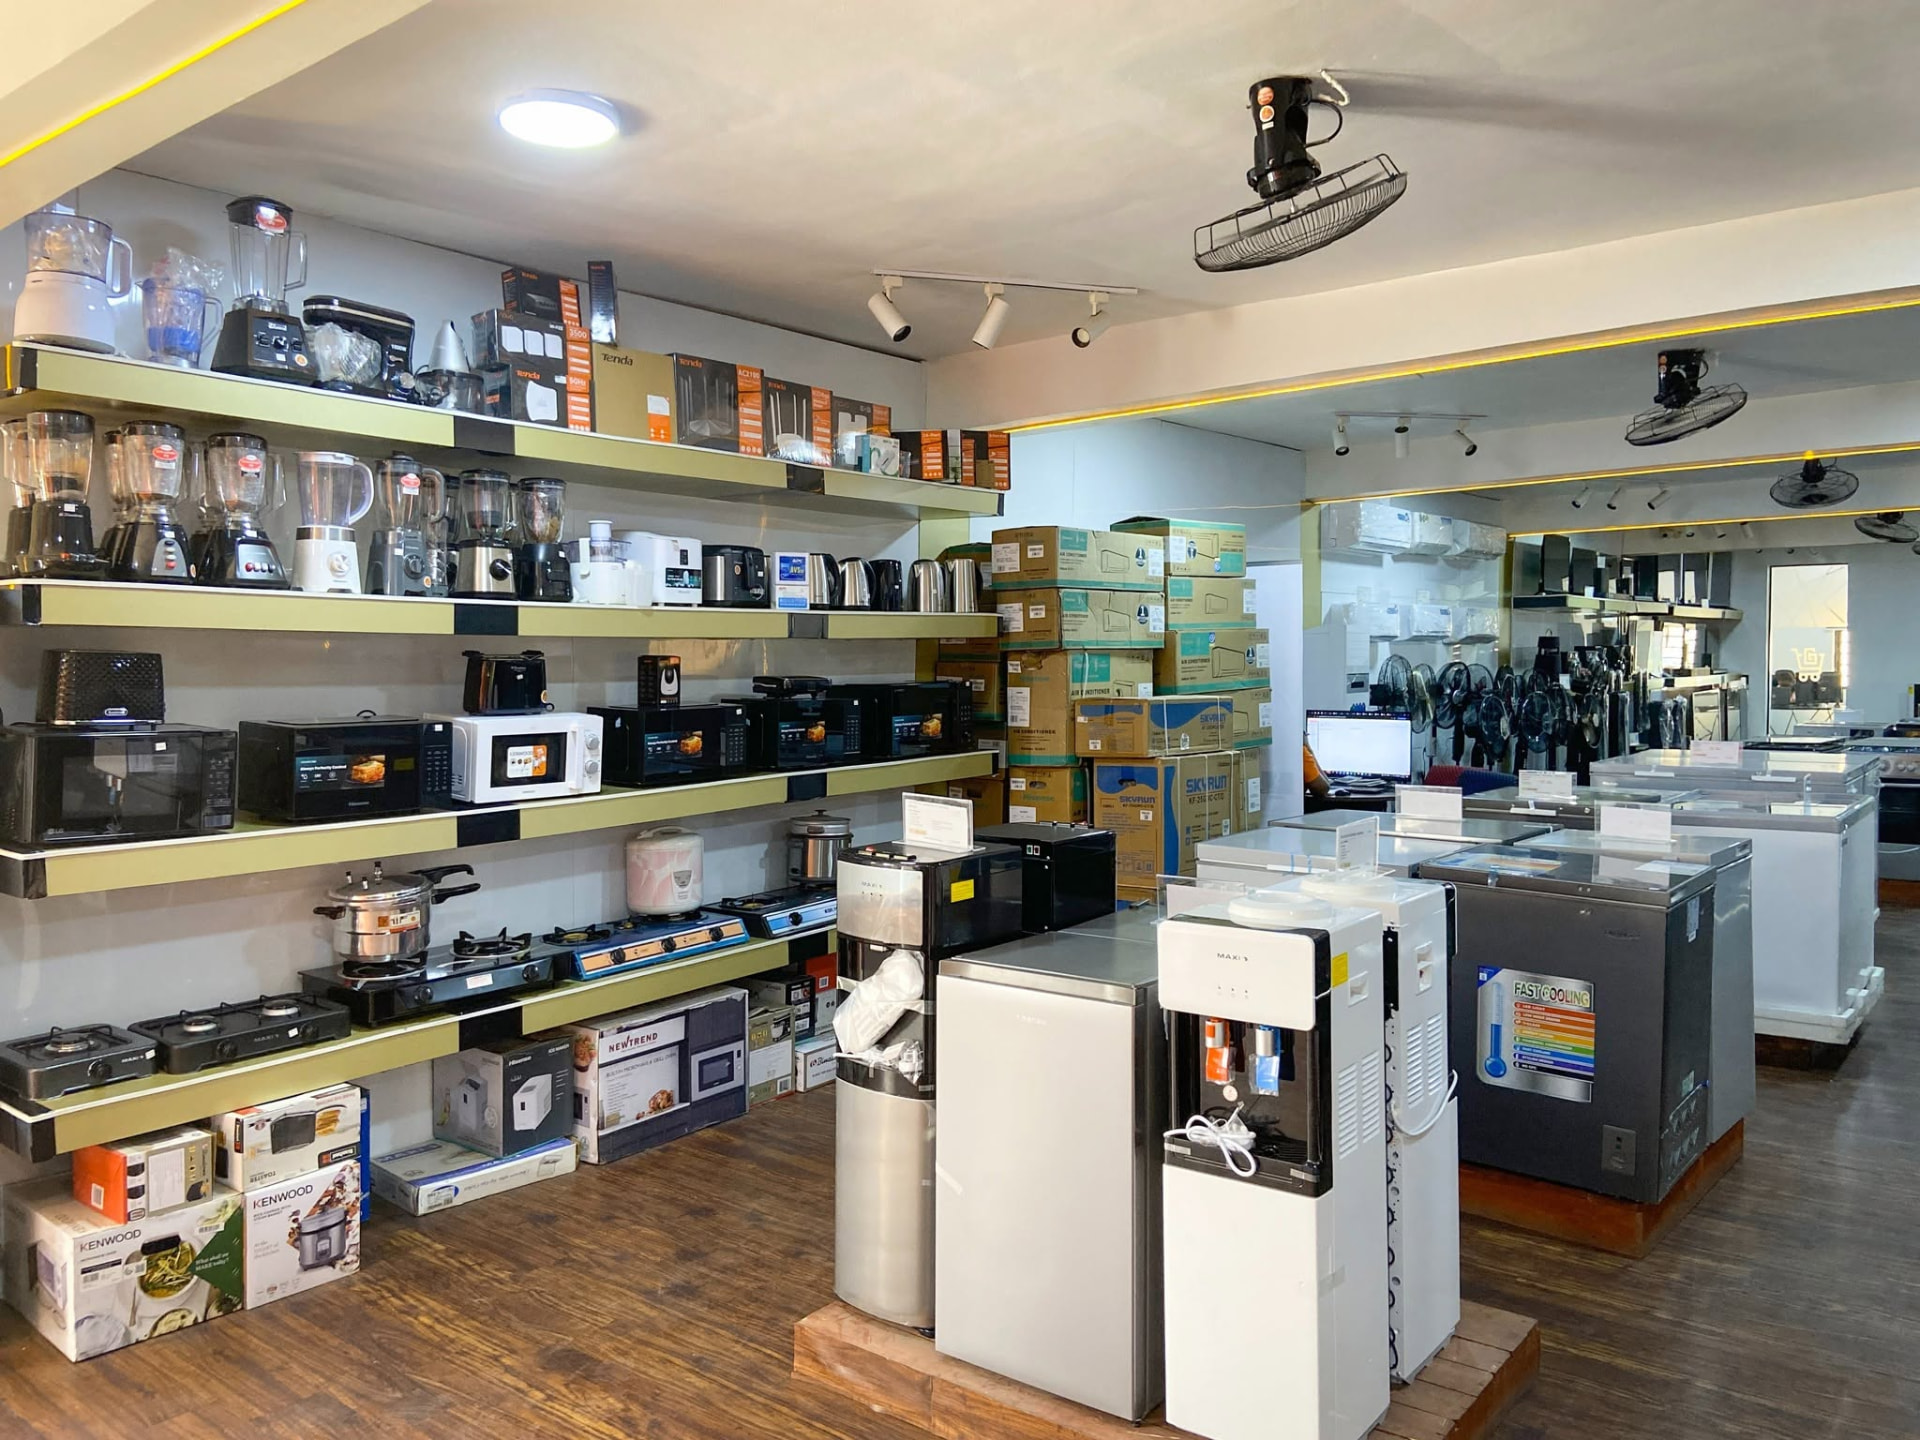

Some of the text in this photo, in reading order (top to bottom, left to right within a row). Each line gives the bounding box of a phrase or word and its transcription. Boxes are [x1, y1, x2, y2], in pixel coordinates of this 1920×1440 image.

[602, 353, 633, 366] Tenda
[678, 358, 702, 368] Tenda
[516, 369, 540, 380] Tenda
[1186, 775, 1227, 793] SKYRUN
[1119, 795, 1156, 803] SKYRUN
[1514, 981, 1591, 1008] FAST COOLING
[608, 1032, 658, 1053] NEWTREND
[250, 1170, 276, 1183] TOASTER
[253, 1184, 313, 1209] KENWOOD
[80, 1229, 142, 1253] KENWOOD
